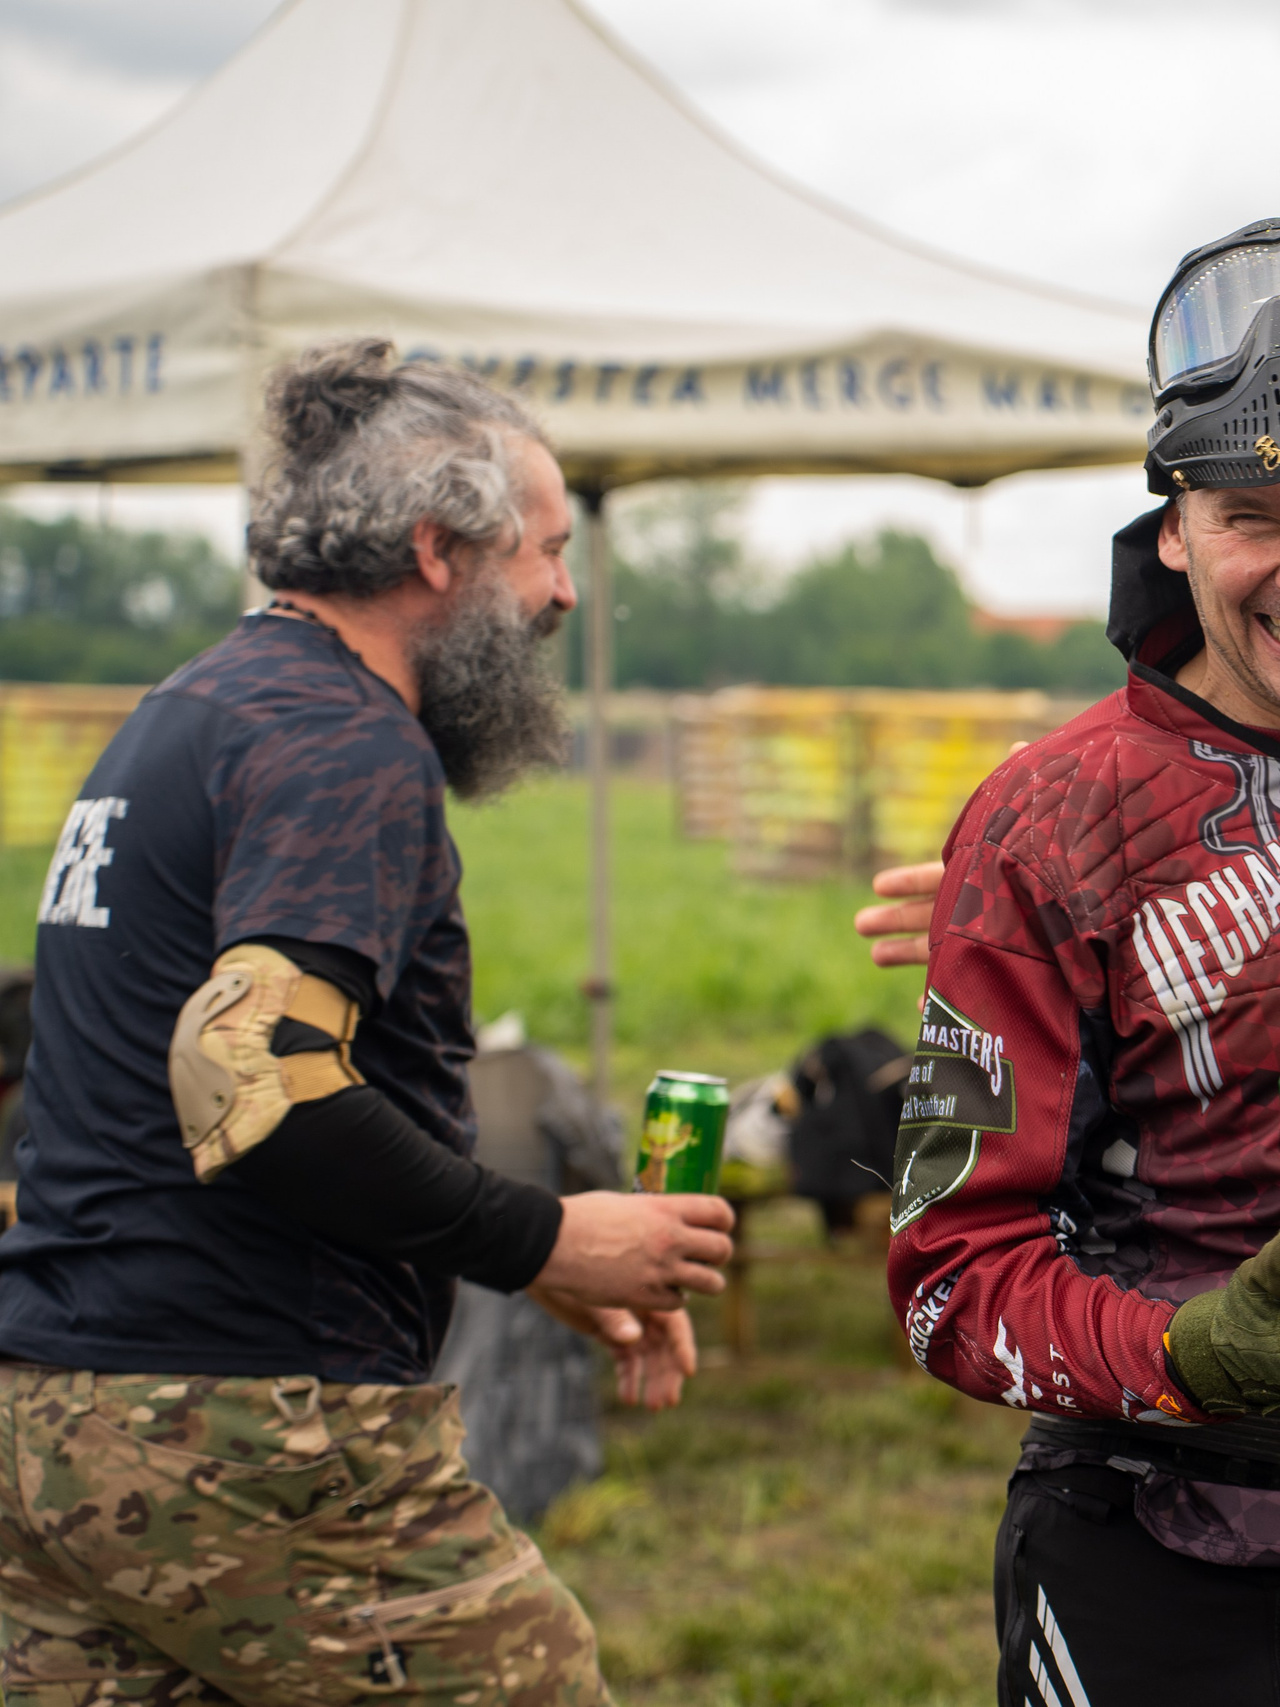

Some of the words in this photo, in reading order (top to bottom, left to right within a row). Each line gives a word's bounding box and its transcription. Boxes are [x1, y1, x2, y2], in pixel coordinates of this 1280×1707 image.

[745, 357, 946, 413] MERGE
[921, 1061, 933, 1082] of
[923, 1024, 1004, 1097] MASTERS
[913, 1095, 956, 1118] Paintball
